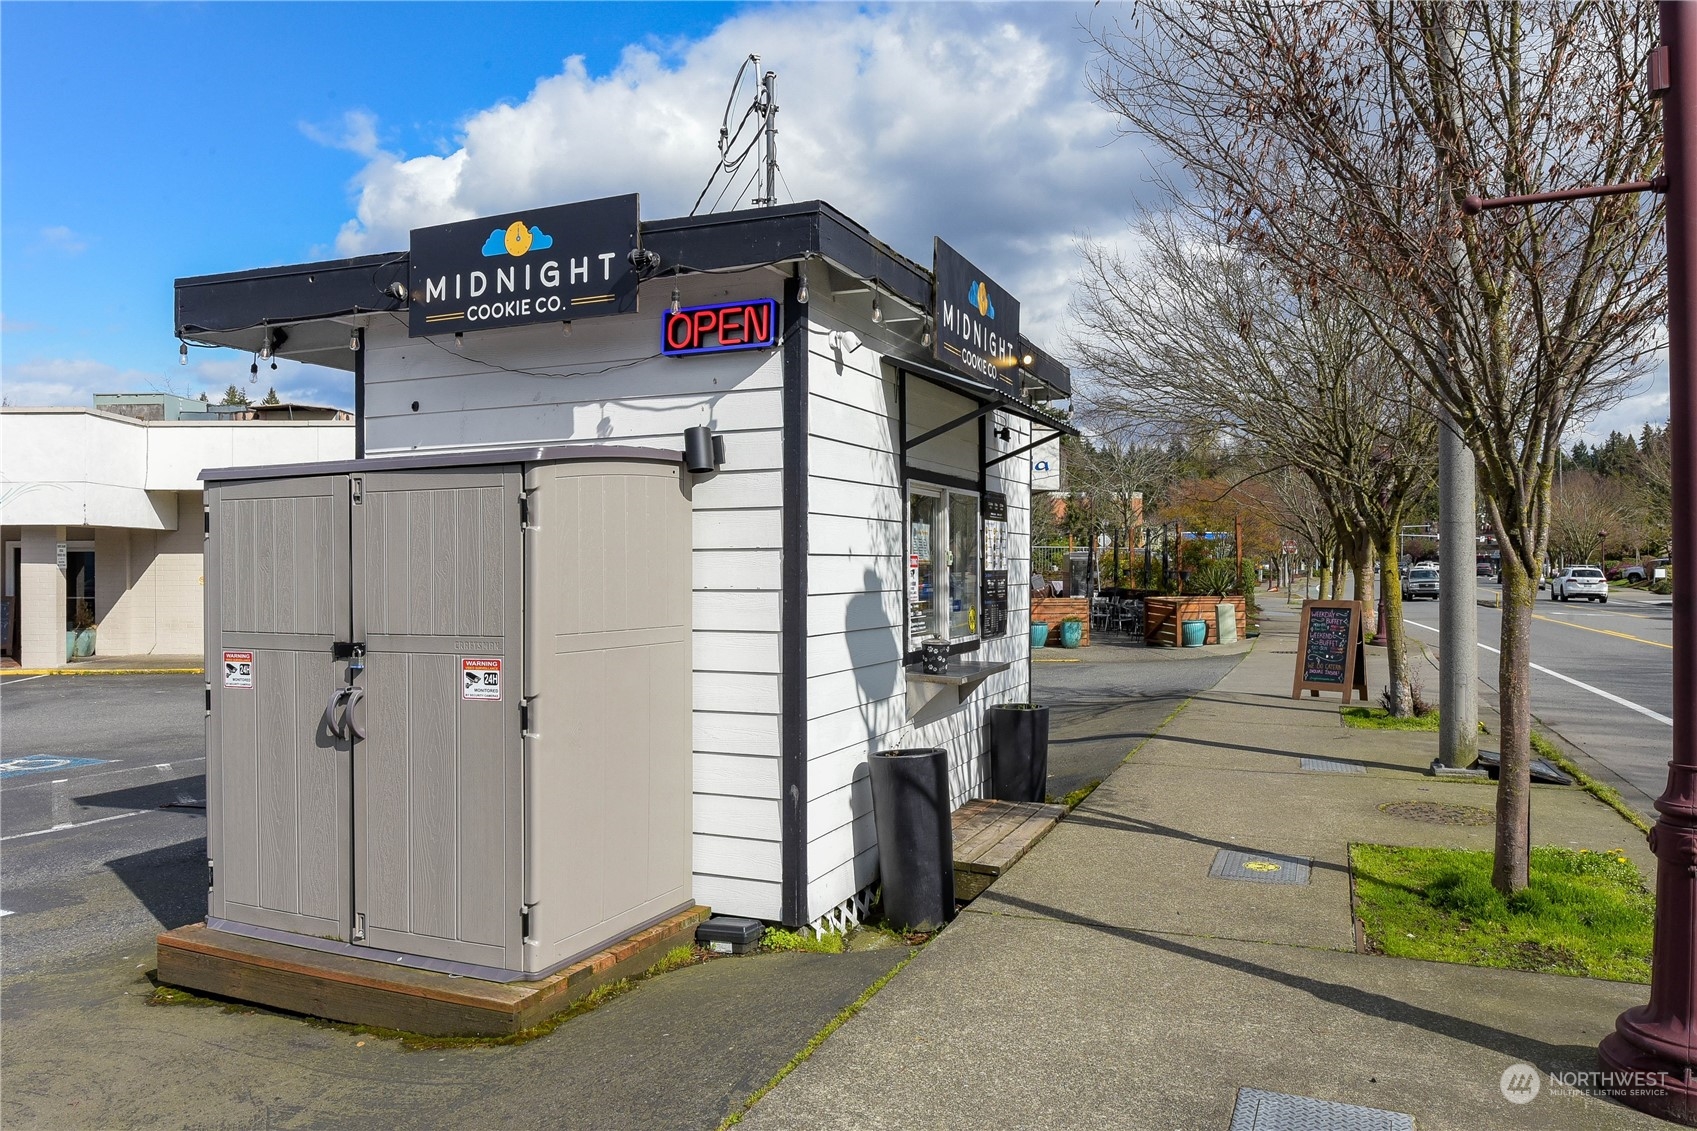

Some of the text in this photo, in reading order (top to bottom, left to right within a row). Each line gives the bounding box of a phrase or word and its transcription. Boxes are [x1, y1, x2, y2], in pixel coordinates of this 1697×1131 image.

[426, 252, 616, 304] MIDNIGHT
[466, 295, 566, 322] COOKIE CO.
[667, 304, 769, 349] OPEN
[943, 299, 1014, 367] MIDNIGHT
[961, 347, 999, 381] COOKIE CO.
[1325, 618, 1343, 626] BUFFET
[1318, 639, 1338, 647] BUFFET
[484, 674, 498, 685] 24H
[1325, 663, 1343, 671] CATERIN
